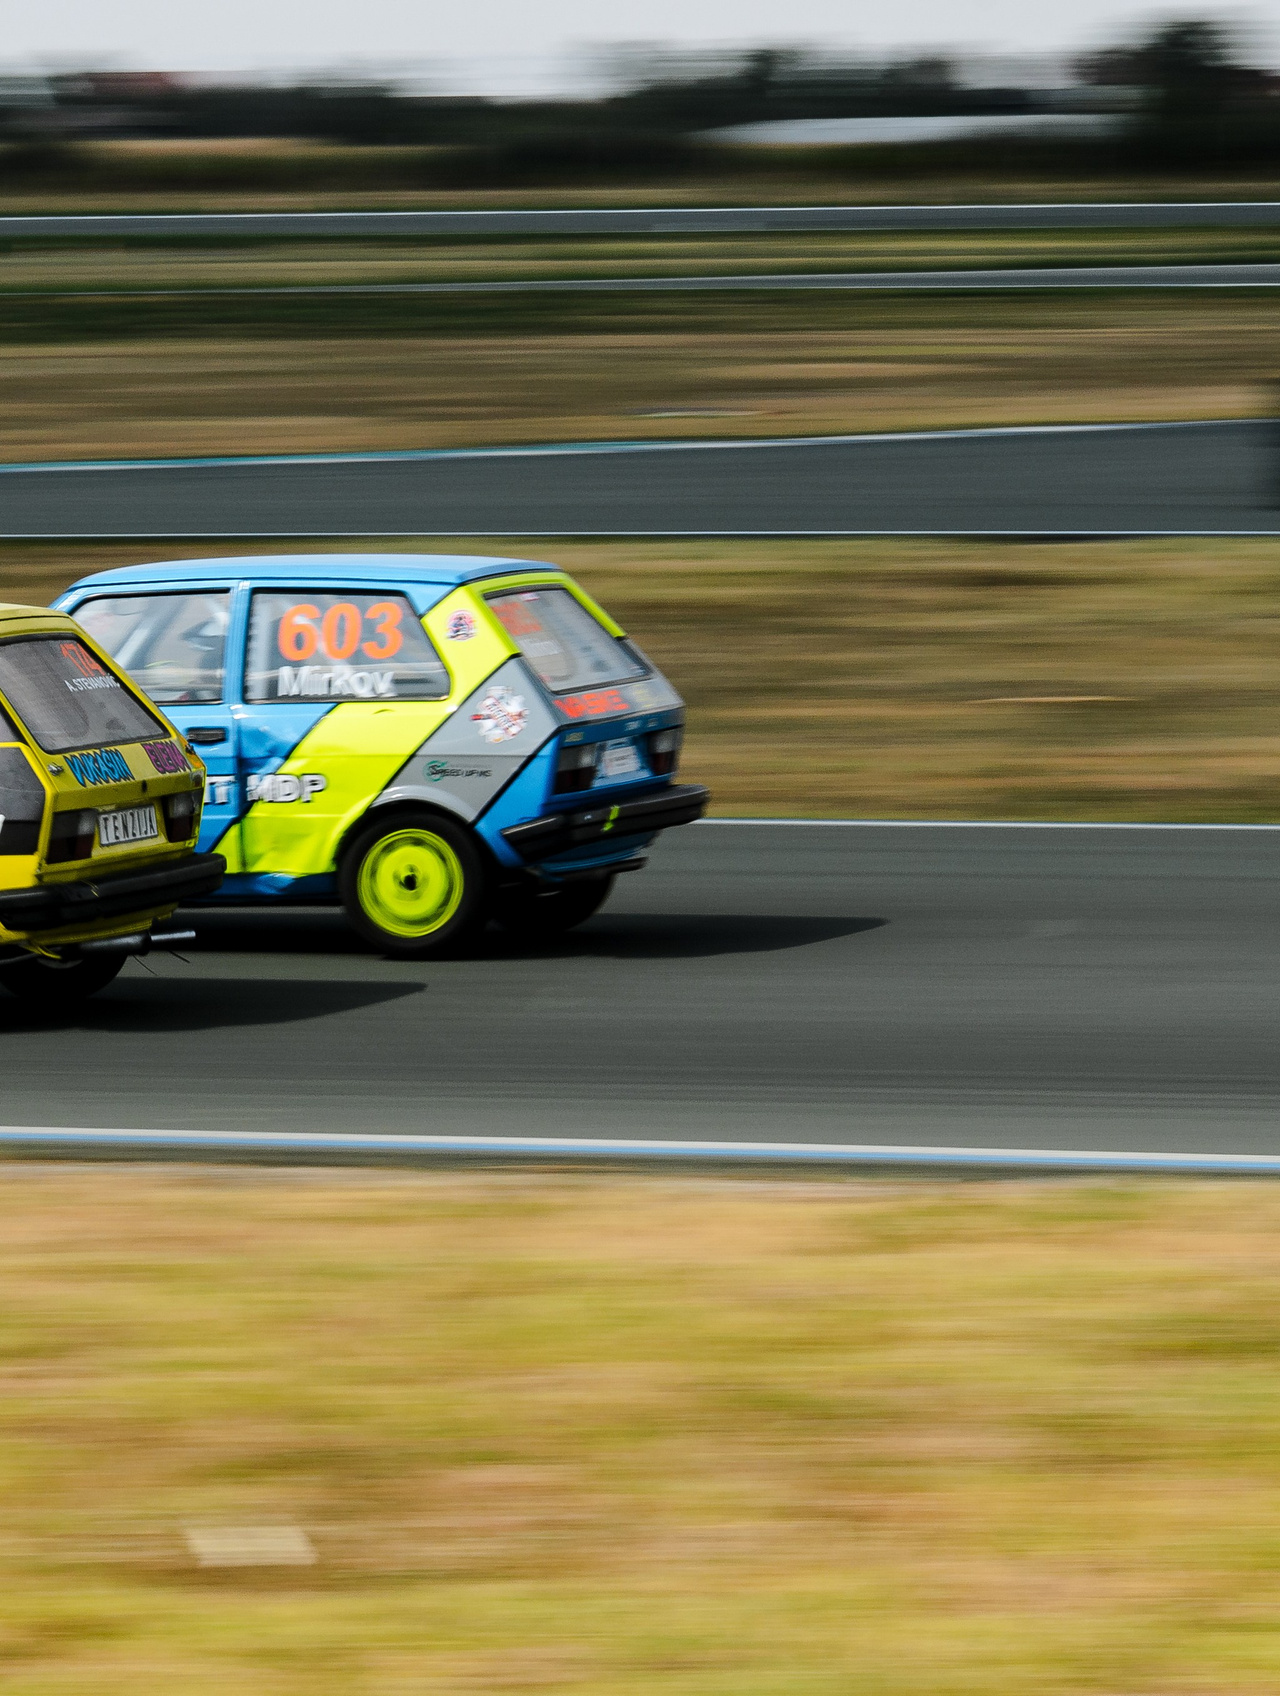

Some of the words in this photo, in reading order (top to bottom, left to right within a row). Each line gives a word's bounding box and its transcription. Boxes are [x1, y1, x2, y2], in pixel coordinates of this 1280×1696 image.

[278, 602, 403, 661] 603
[60, 643, 107, 677] 174
[102, 811, 155, 843] TENZIJA
